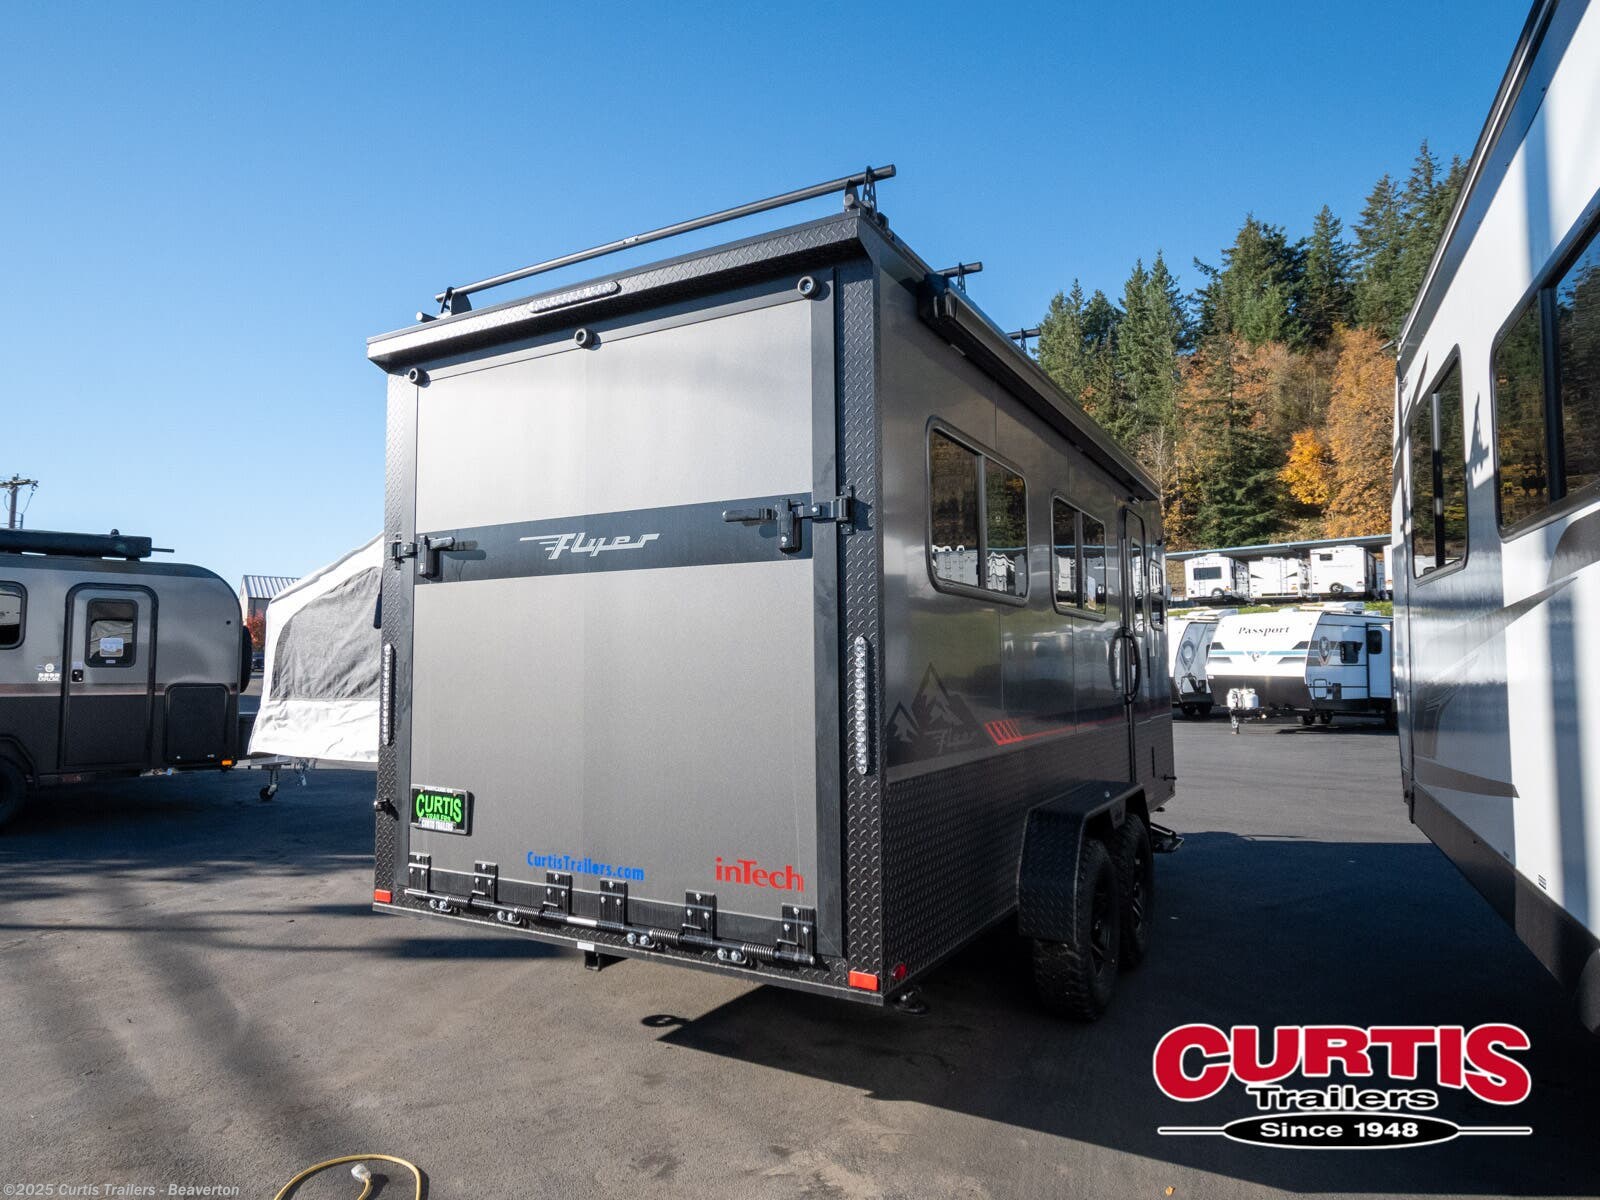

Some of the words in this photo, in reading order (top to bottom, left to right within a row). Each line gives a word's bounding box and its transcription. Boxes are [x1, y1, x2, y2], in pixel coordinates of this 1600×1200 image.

[520, 532, 660, 560] Flyer
[1239, 626, 1290, 637] Passport
[416, 794, 462, 823] CURTIS
[527, 851, 645, 881] CurtisTrailers.com
[715, 856, 804, 892] inTech
